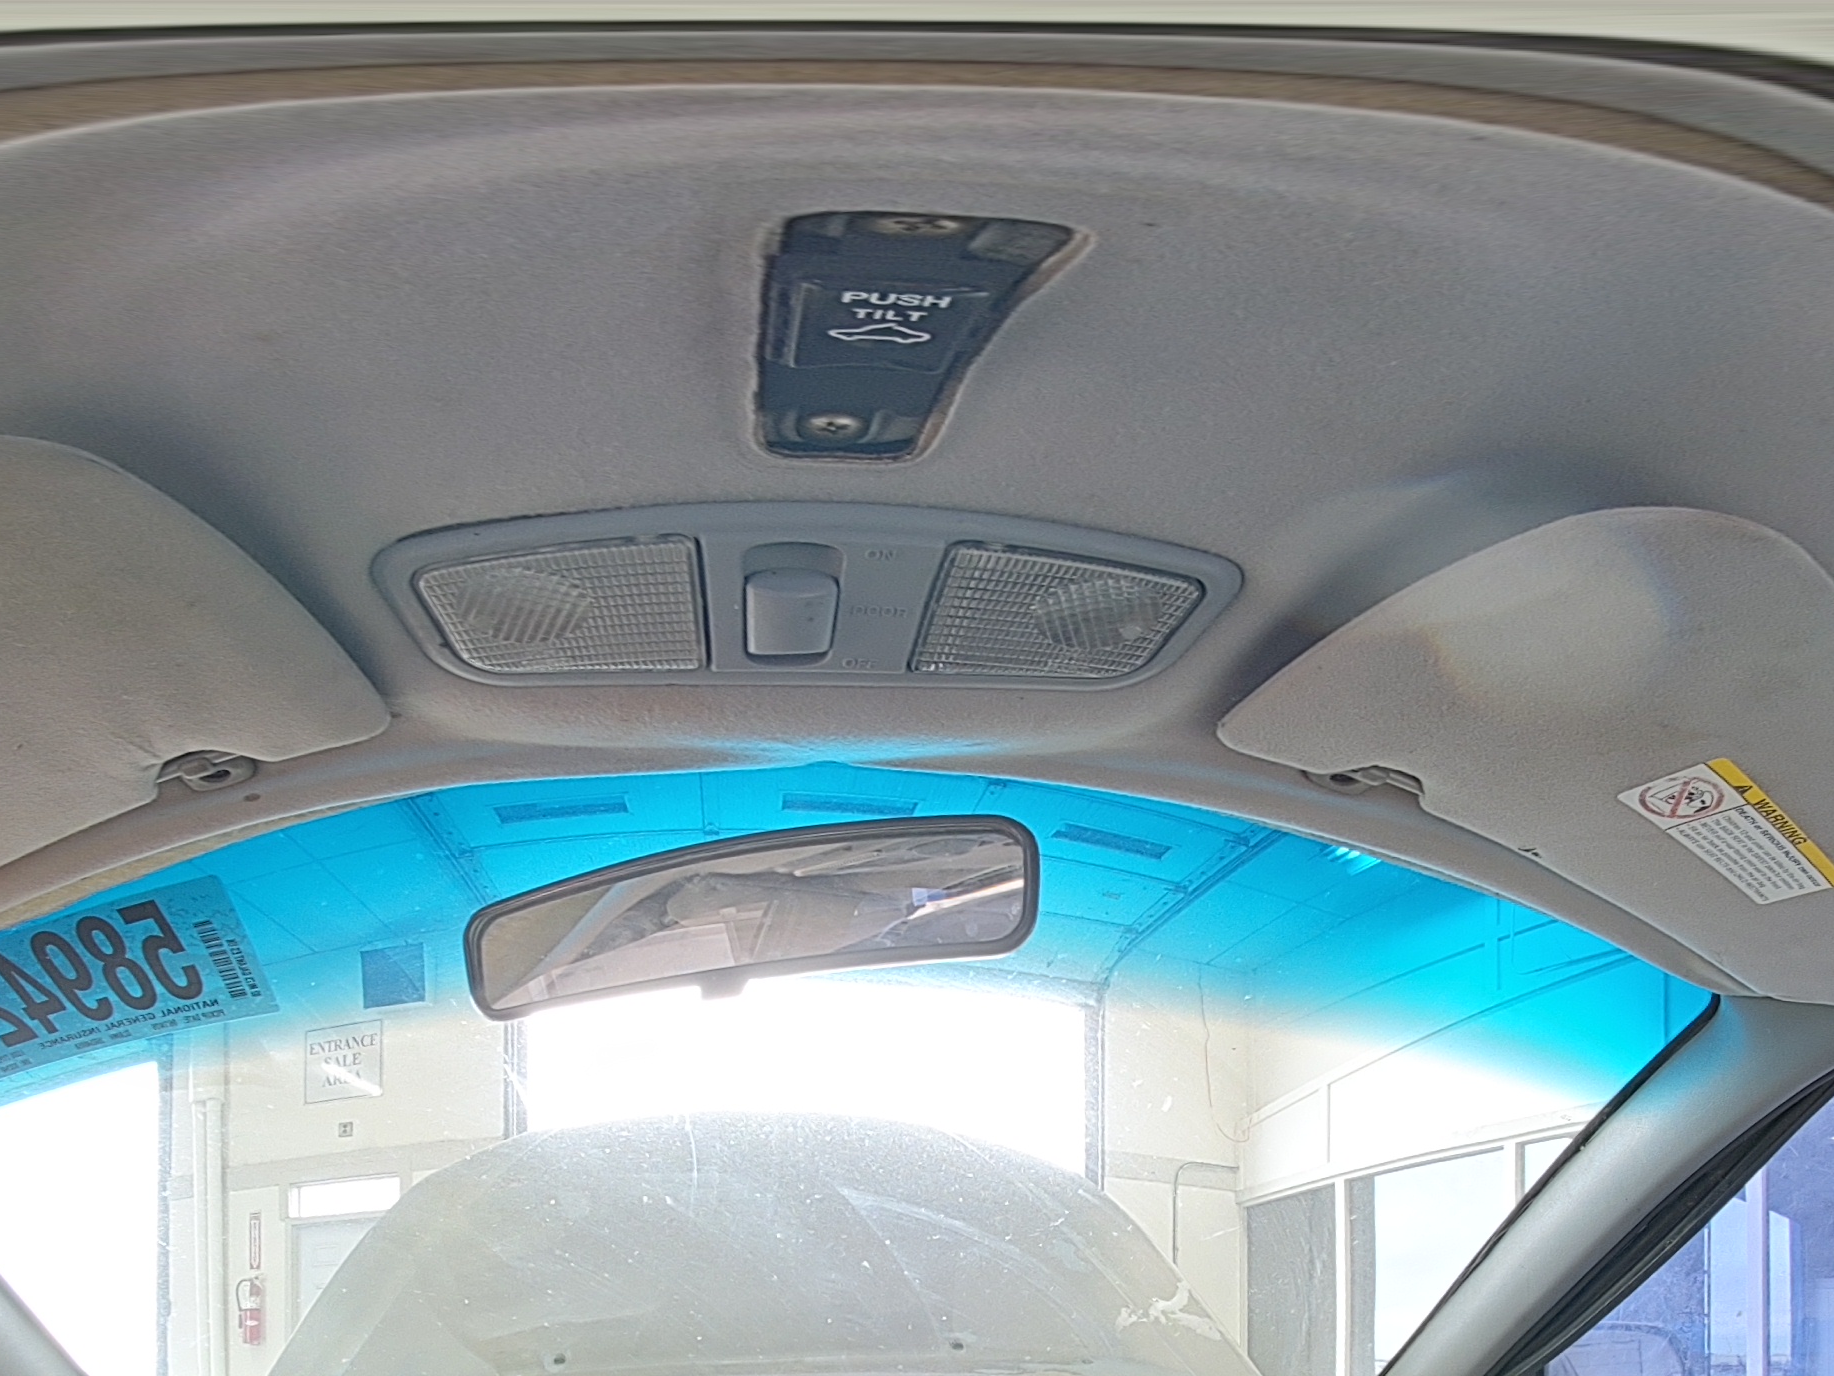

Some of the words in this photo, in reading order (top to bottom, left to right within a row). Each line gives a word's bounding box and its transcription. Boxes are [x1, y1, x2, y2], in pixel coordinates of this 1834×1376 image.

[841, 291, 952, 309] PUSH
[852, 308, 928, 322] TILT
[865, 549, 896, 561] ON
[850, 605, 908, 618] DOOR
[842, 657, 879, 669] OFF
[1752, 798, 1808, 847] WARNING
[309, 1033, 377, 1055] ENTRANCE
[324, 1052, 362, 1067] SALE
